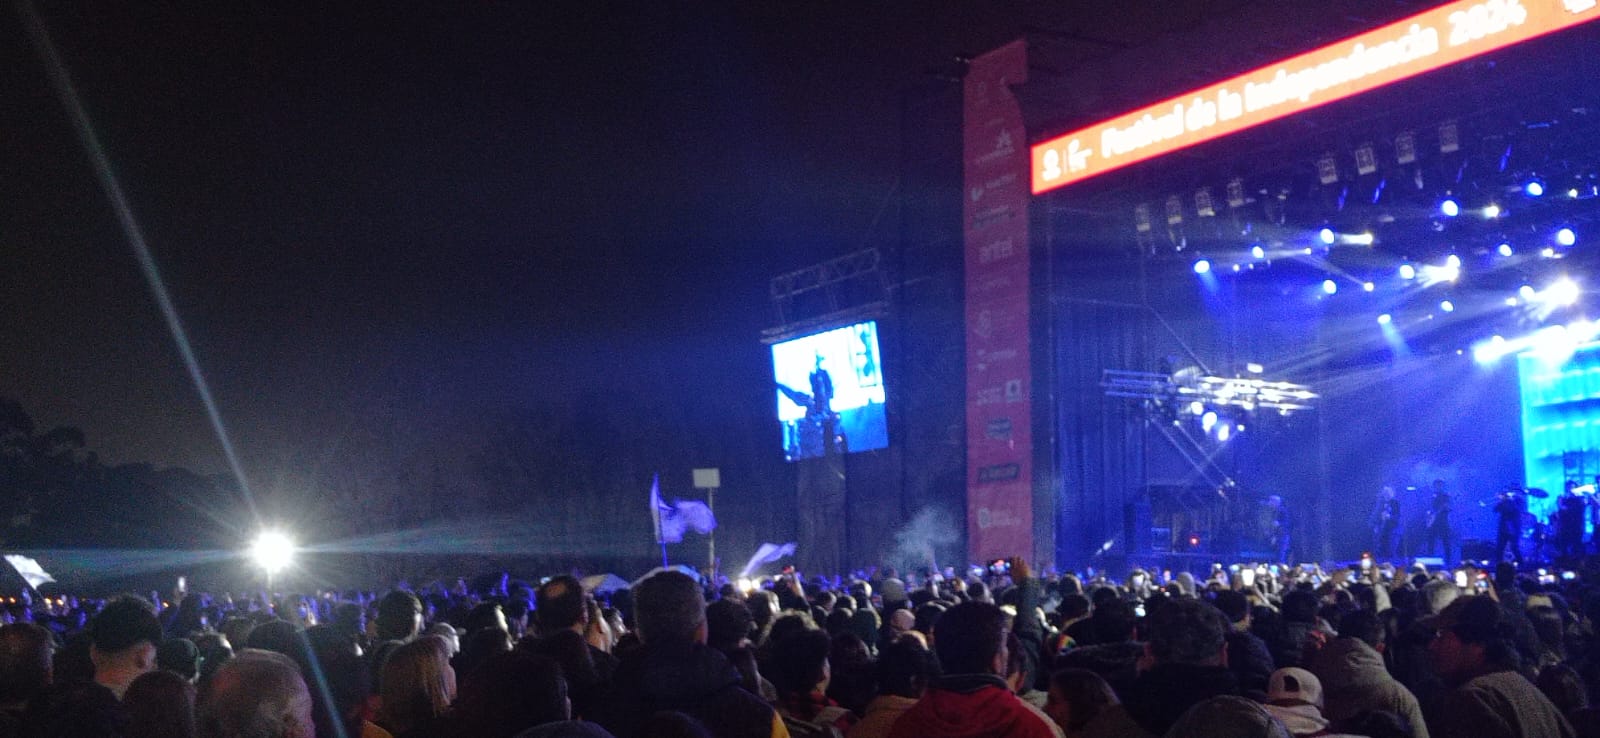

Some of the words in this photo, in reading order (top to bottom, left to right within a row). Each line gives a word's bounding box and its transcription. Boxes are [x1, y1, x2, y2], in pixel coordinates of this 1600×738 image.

[1101, 103, 1184, 158] Festival
[1185, 97, 1216, 131] de
[1218, 88, 1242, 121] la
[1244, 23, 1438, 112] Independencia
[1448, 0, 1527, 46] 2024
